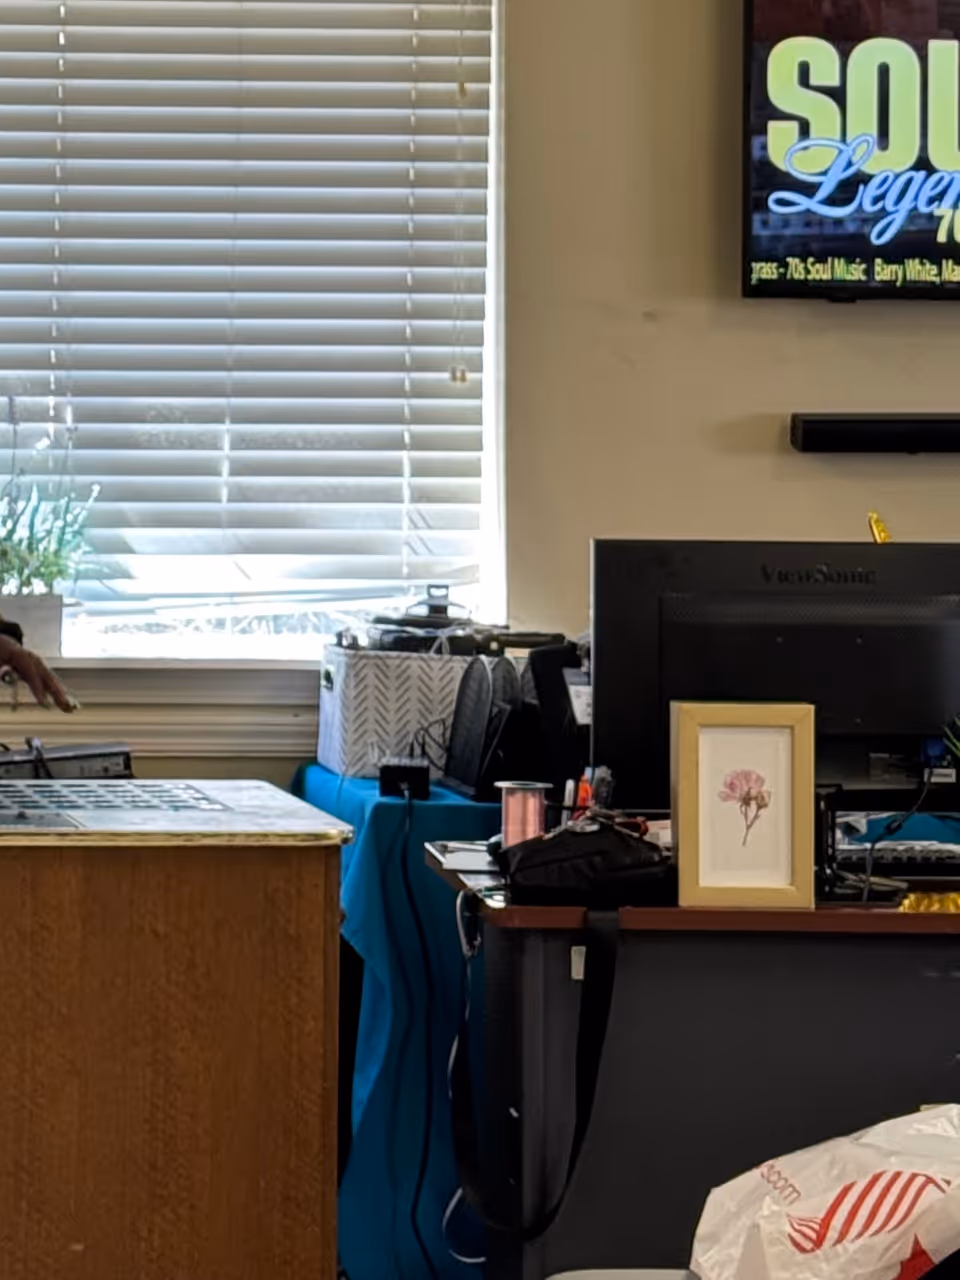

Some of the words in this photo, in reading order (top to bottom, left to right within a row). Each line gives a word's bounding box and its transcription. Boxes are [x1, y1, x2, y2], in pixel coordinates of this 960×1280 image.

[785, 256, 805, 280] 70s
[807, 256, 832, 281] Soul
[833, 256, 867, 281] Music
[874, 258, 903, 287] Barry
